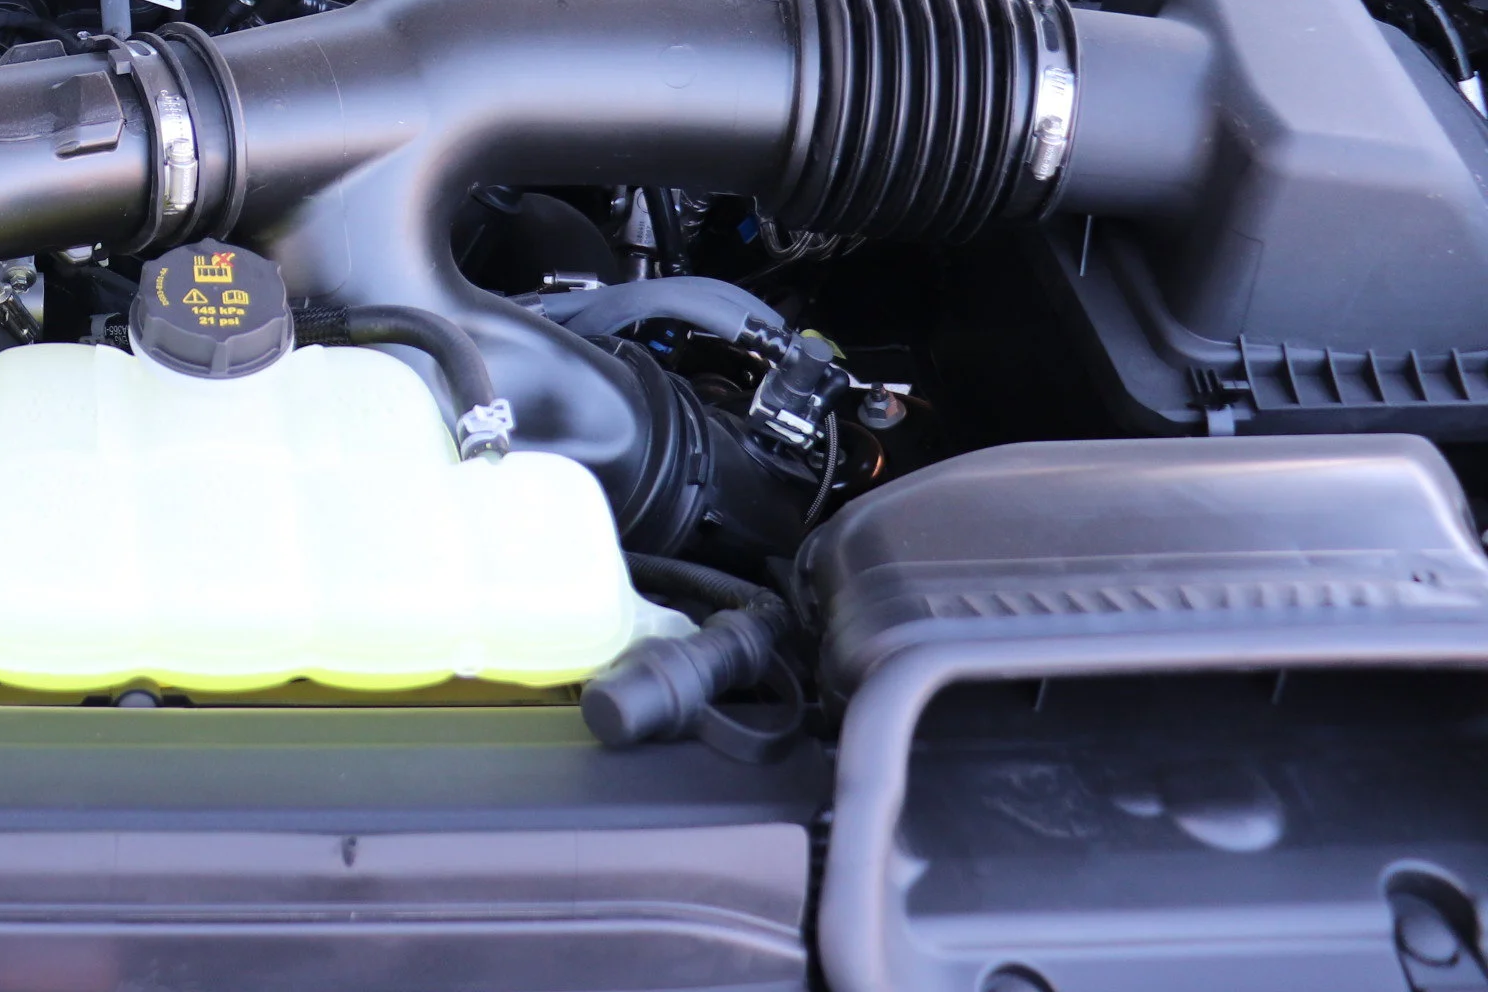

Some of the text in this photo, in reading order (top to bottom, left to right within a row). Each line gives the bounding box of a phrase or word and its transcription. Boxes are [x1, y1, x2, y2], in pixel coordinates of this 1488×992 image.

[191, 306, 245, 316] 145 kPa
[198, 316, 240, 327] 21 psi
